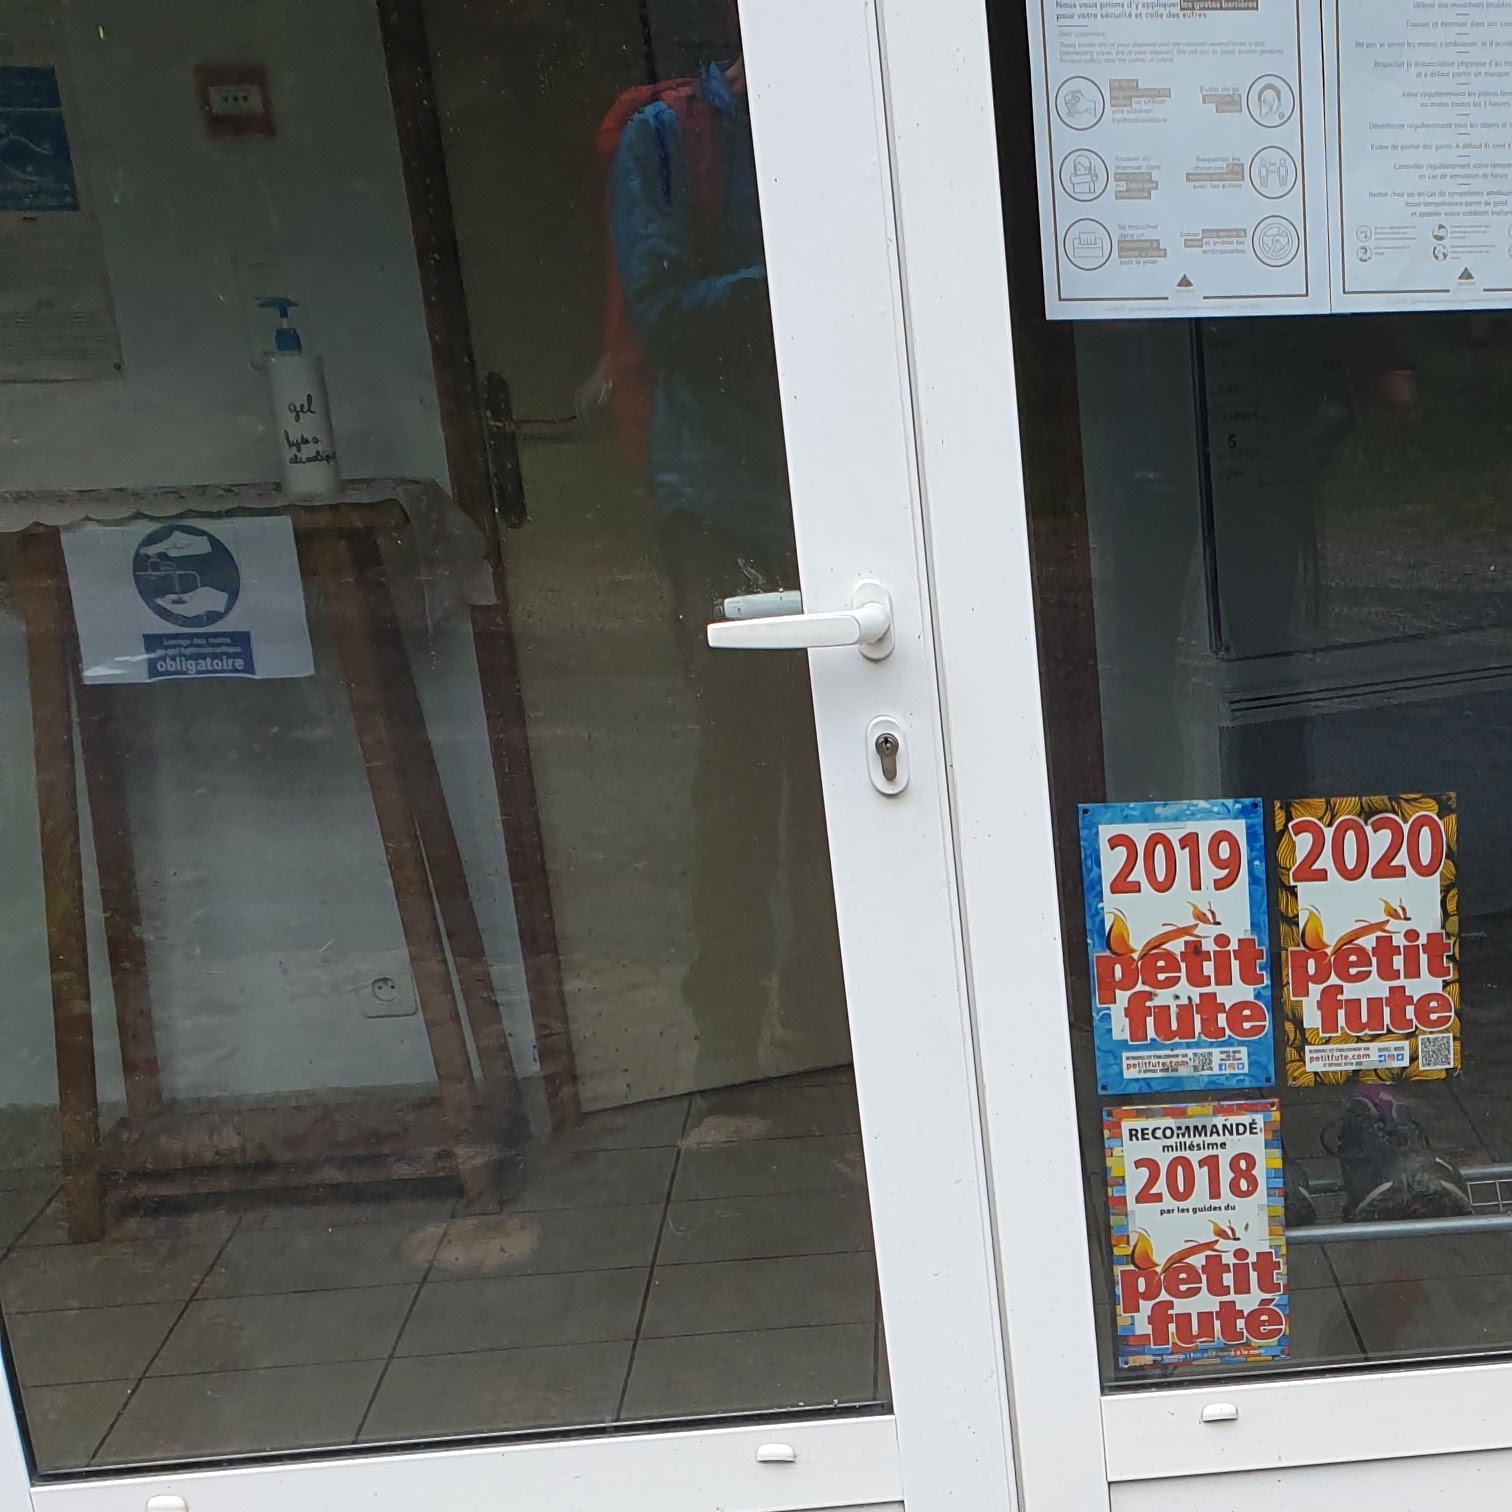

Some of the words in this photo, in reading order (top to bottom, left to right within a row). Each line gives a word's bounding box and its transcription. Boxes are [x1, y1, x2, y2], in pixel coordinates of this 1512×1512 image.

[287, 393, 317, 423] gel
[156, 655, 246, 675] obligatoire
[1106, 828, 1243, 896] 2019
[1289, 813, 1445, 884] 2020
[1094, 933, 1266, 1006] petit
[1288, 928, 1453, 999] petit
[1309, 1051, 1371, 1064] petitfute.com
[1128, 1118, 1259, 1142] RECOMMANDÉ
[1161, 1140, 1228, 1154] millésime
[1133, 1151, 1260, 1205] 2018
[1160, 1207, 1176, 1217] par
[1177, 1205, 1191, 1215] les
[1192, 1204, 1223, 1215] guides
[1224, 1203, 1237, 1212] du
[1119, 1247, 1283, 1315] petit
[1147, 1297, 1285, 1348] futé
